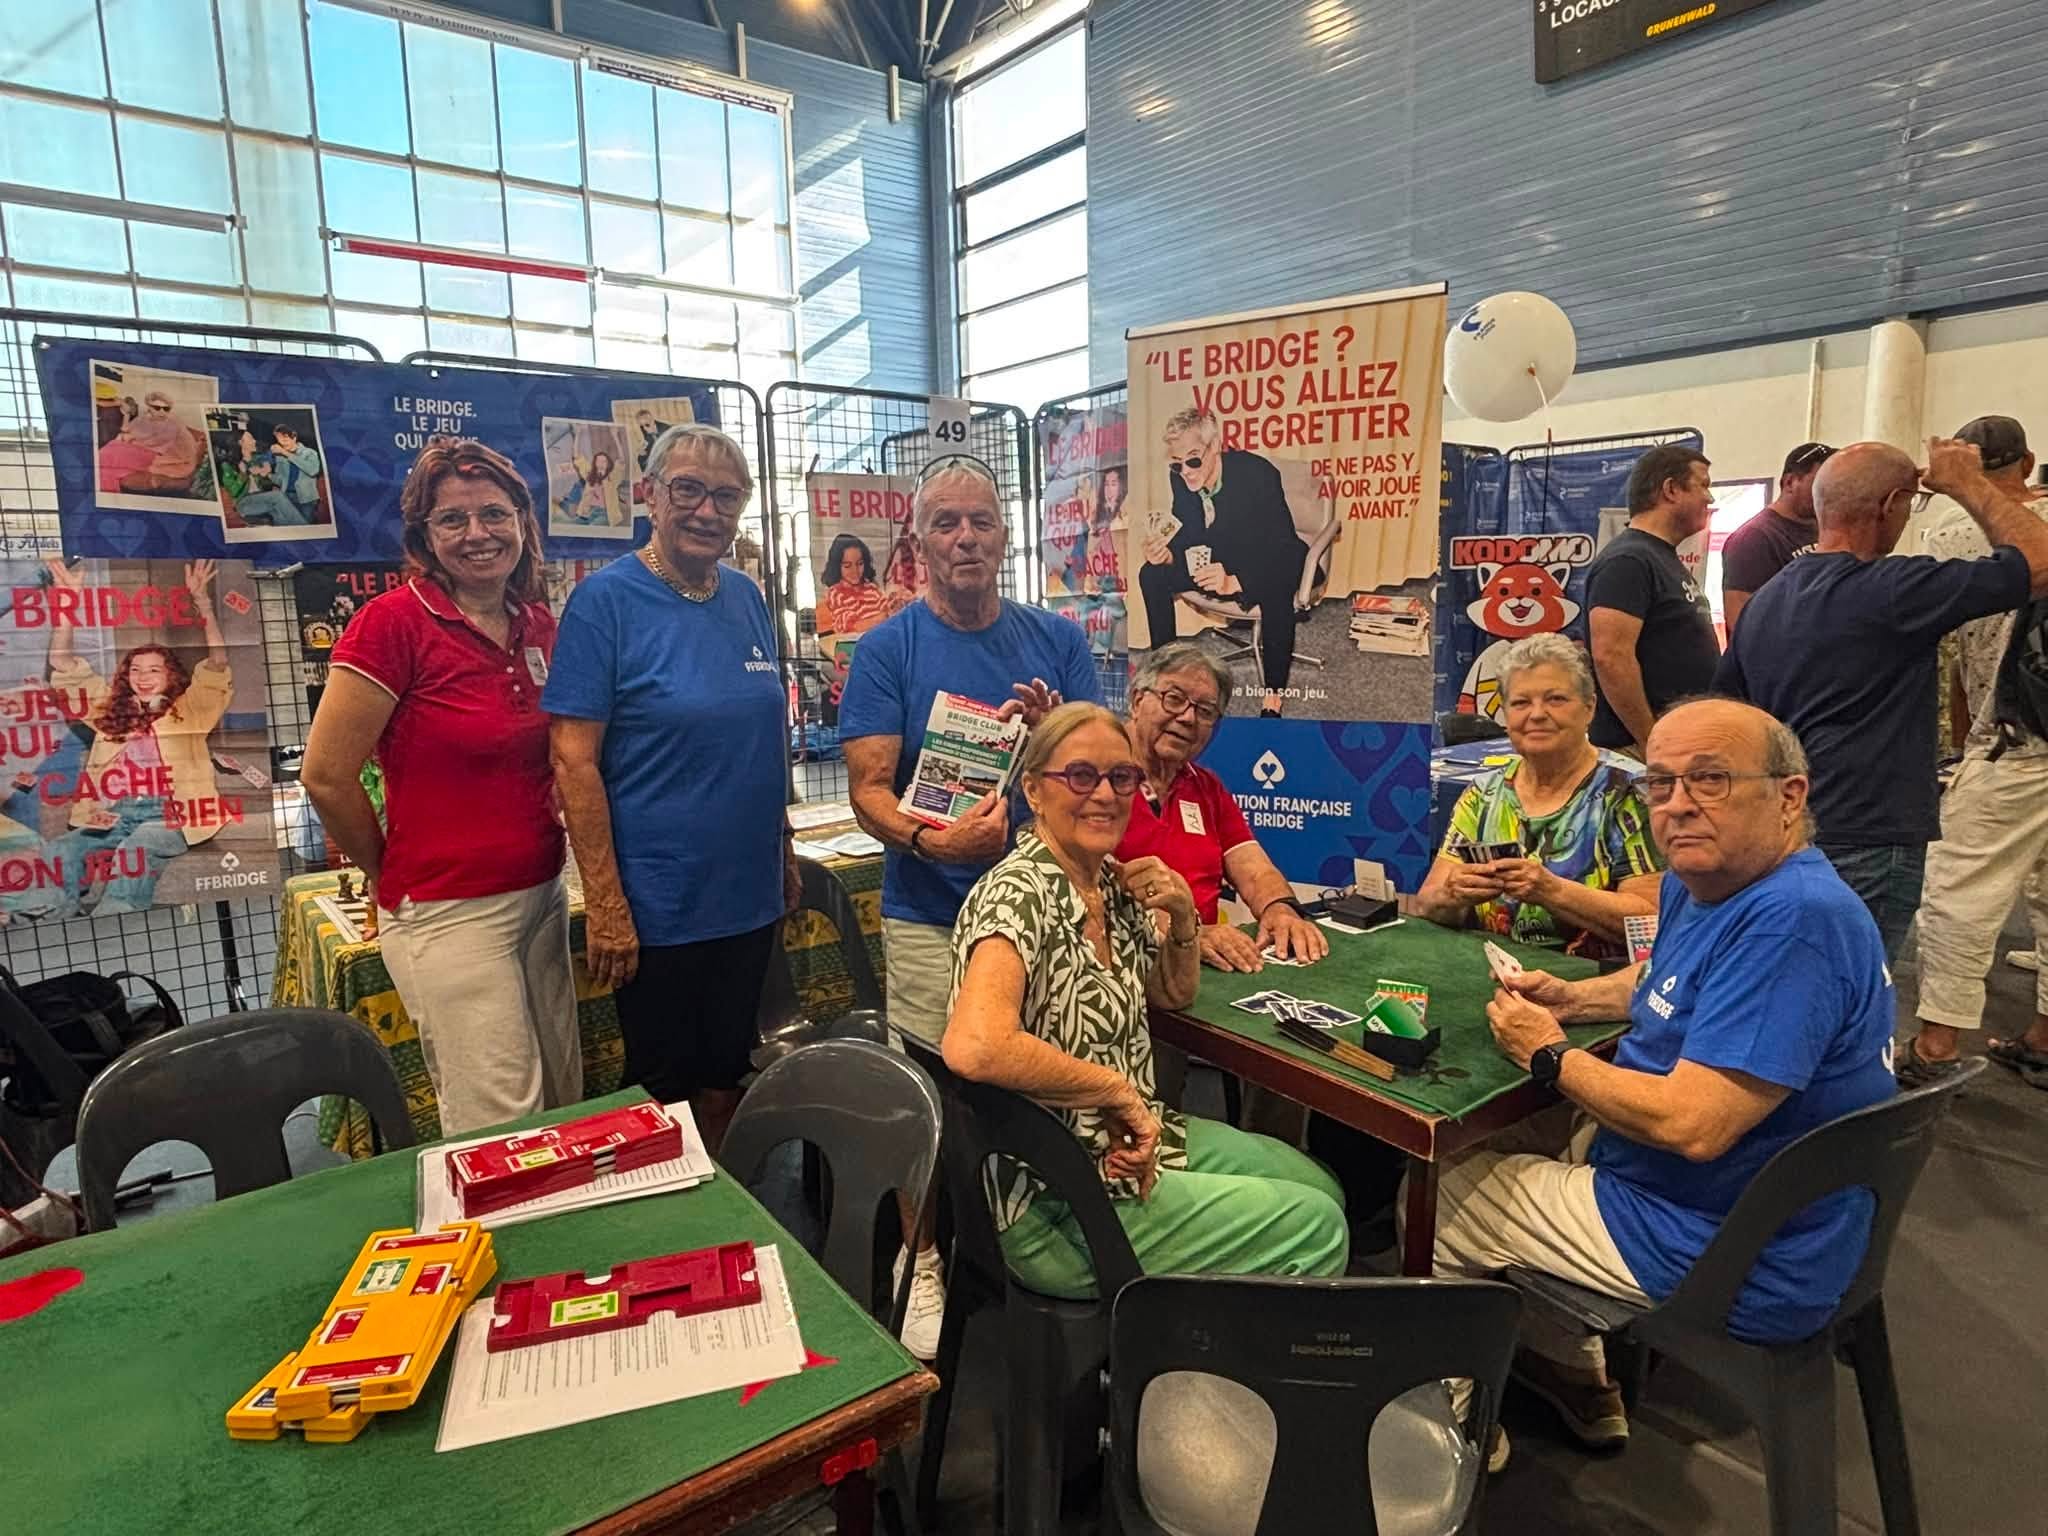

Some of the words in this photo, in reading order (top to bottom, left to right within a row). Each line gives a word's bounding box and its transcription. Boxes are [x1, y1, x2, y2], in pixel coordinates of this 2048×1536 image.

[1646, 3, 1716, 37] GRUNENWALD
[1204, 330, 1319, 378] BRIDGE
[1333, 325, 1354, 361] ?
[1192, 374, 1285, 415] VOUS
[1297, 361, 1398, 406] ALLEZ
[394, 396, 411, 413] LE
[416, 398, 477, 418] BRIDGE.
[412, 416, 428, 432] LE
[433, 418, 462, 433] JEU
[936, 421, 966, 443] 49
[1222, 403, 1410, 451] REGRETTER
[394, 433, 423, 450] QUI
[1312, 458, 1331, 477] DE
[1336, 457, 1357, 476] NE
[1363, 454, 1396, 474] PAS
[1401, 452, 1415, 473] Y
[1318, 478, 1371, 500] AVOIR
[1375, 469, 1421, 496] JOUÉ
[814, 489, 841, 518] LE
[1454, 536, 1591, 566] KODOMO
[12, 586, 207, 629] BRIDGE.
[16, 687, 89, 722] JEU
[1246, 685, 1274, 697] bien
[1277, 688, 1300, 698] son
[1303, 685, 1328, 701] jeu.
[39, 765, 175, 806] CACHE
[164, 797, 243, 829] BIEN
[1254, 812, 1304, 830] BRIDGE
[1273, 796, 1352, 817] FRANÇAISE
[0, 856, 64, 893] ON
[195, 871, 268, 892] FFBRIDGE
